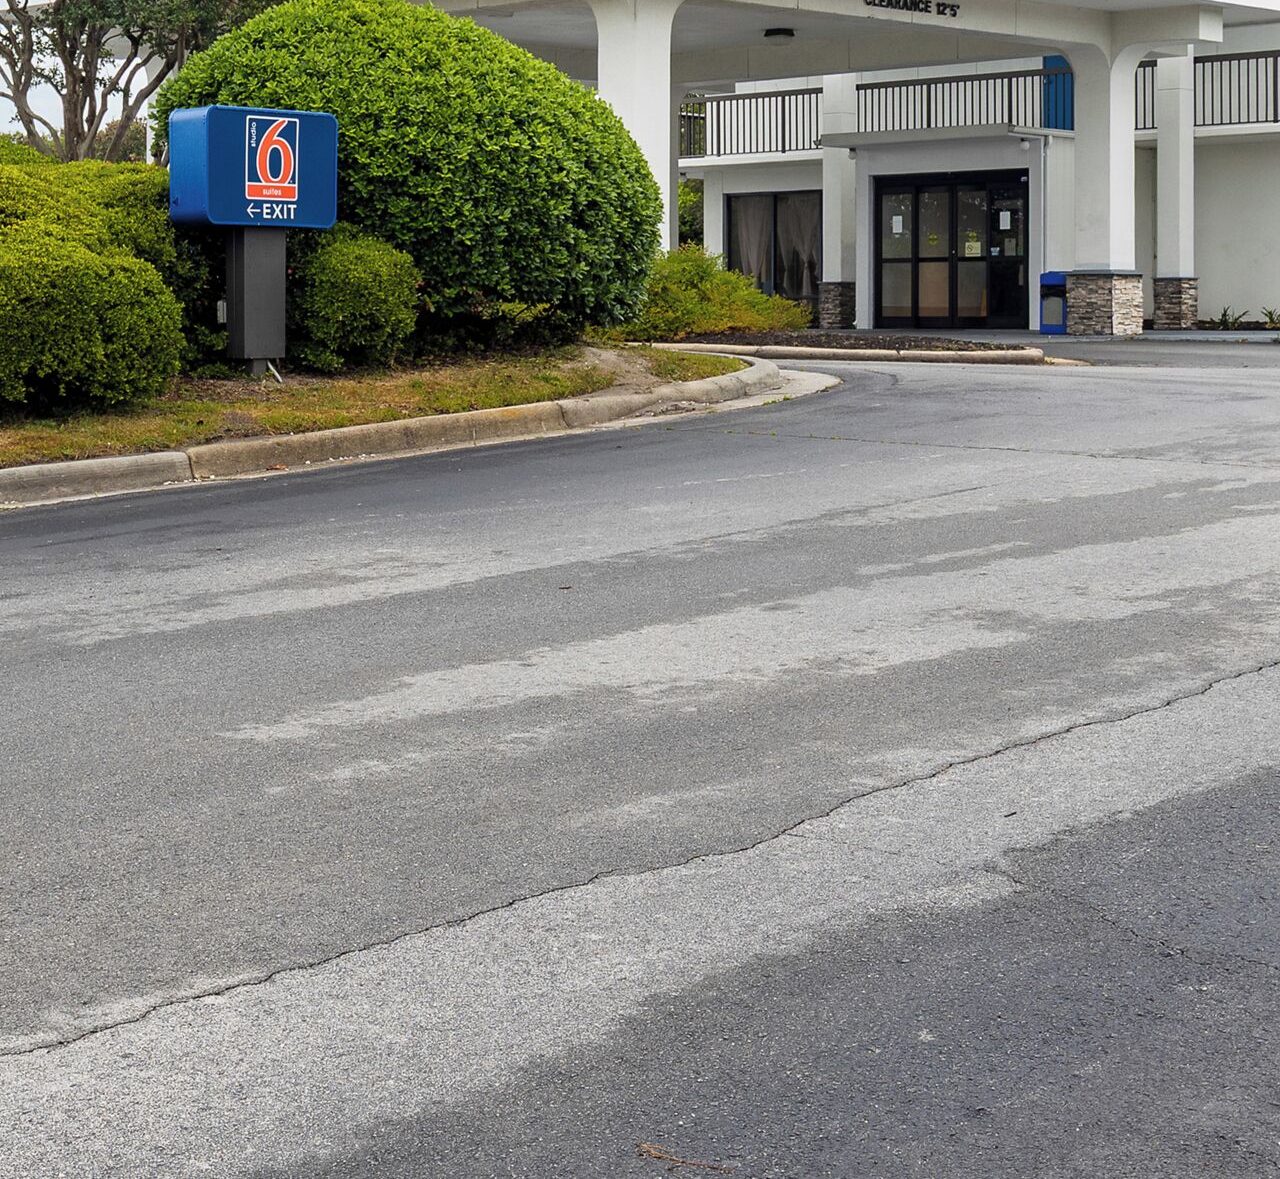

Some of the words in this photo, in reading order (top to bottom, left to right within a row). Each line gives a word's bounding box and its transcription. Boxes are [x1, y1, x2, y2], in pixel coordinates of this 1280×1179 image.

[256, 119, 294, 184] 6
[262, 188, 282, 196] suites
[263, 204, 297, 219] EXIT
